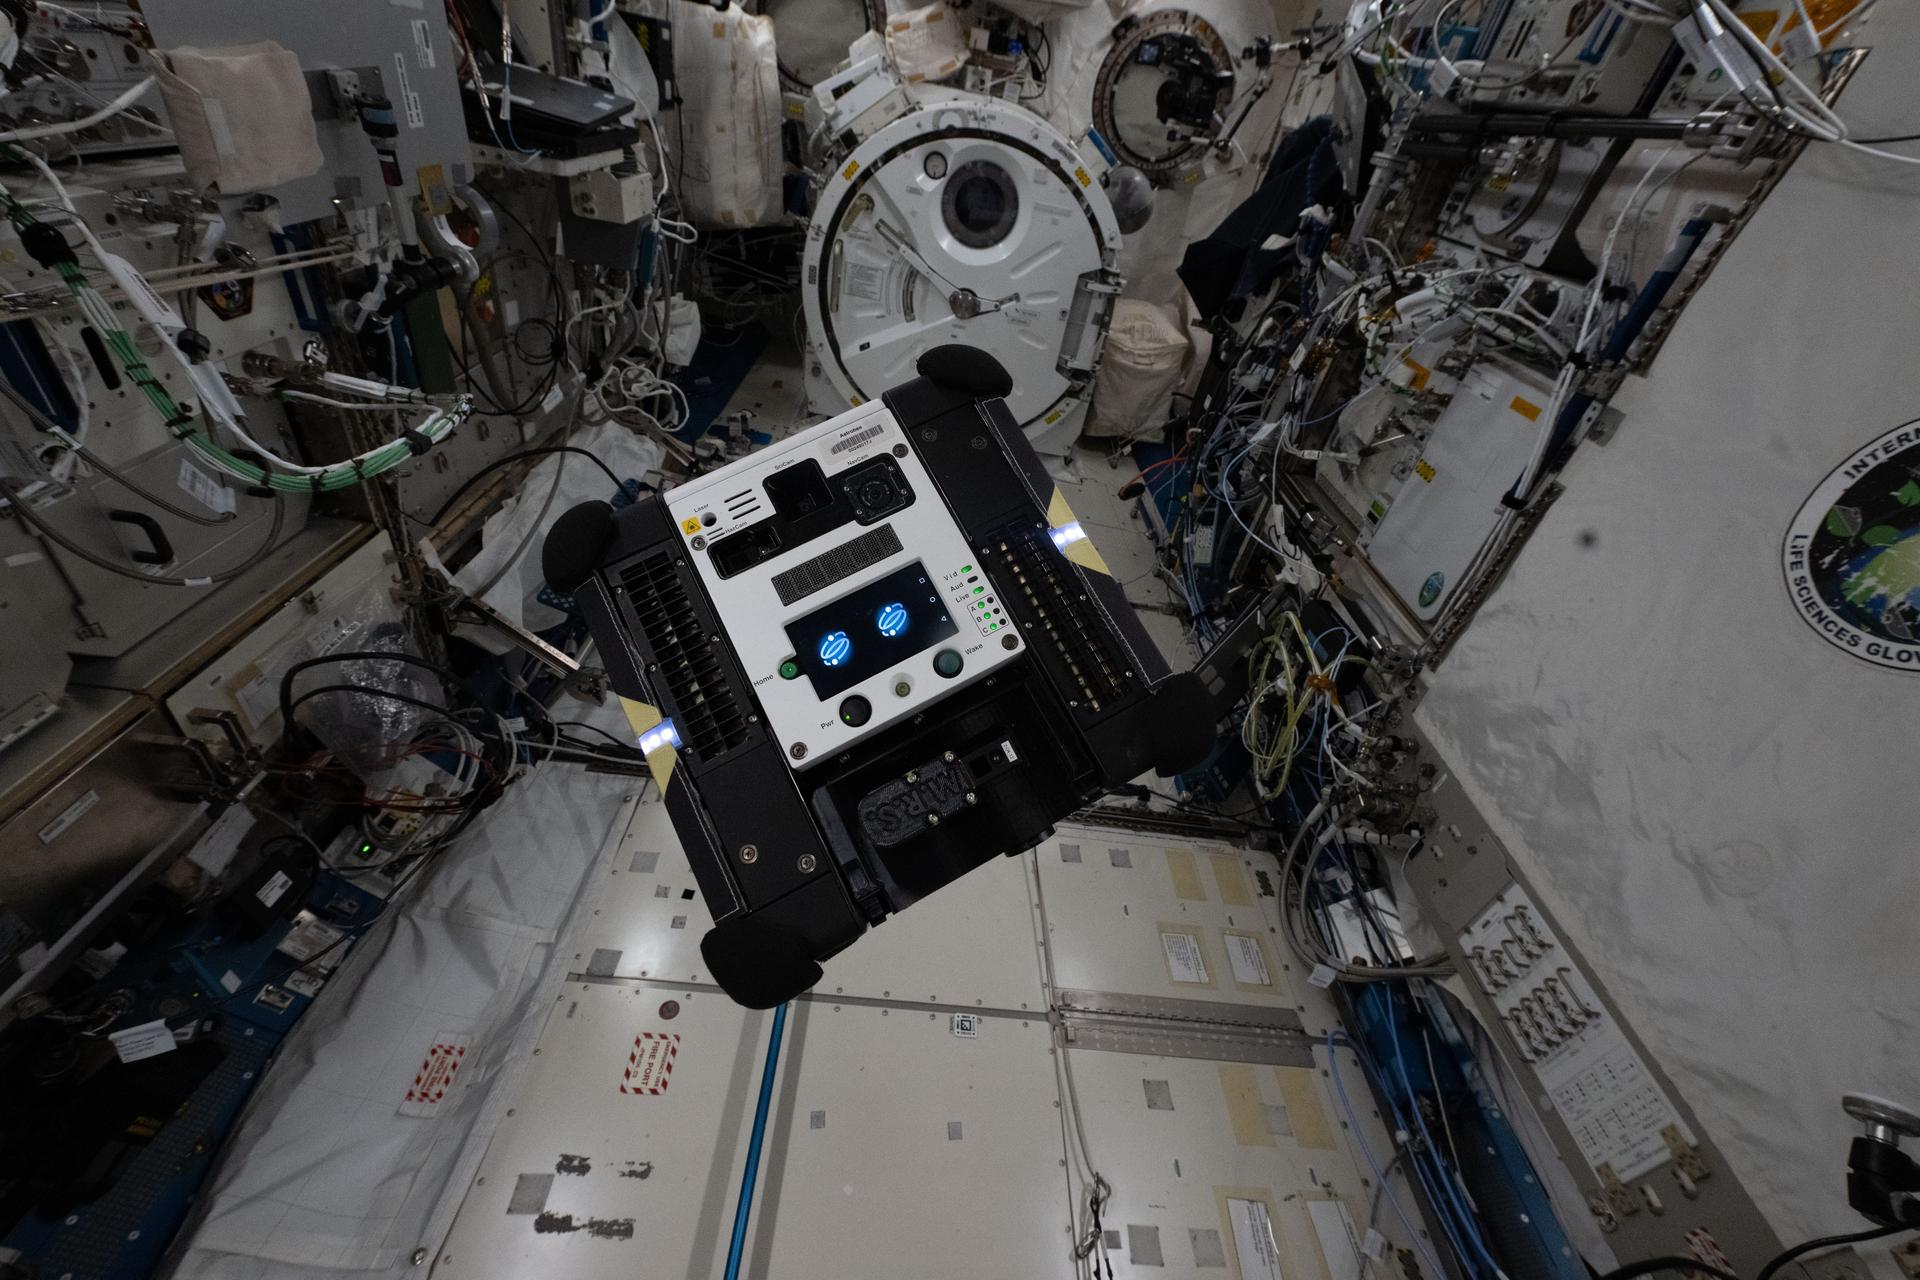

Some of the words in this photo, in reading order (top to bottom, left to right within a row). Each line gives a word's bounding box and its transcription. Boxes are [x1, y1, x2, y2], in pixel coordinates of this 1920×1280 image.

[840, 426, 862, 438] Astrobee
[774, 459, 795, 471] SciCam
[847, 454, 869, 466] NavCam
[693, 503, 709, 513] Laser
[725, 520, 749, 534] HazCam
[1790, 533, 1809, 571] LIFE
[944, 571, 958, 581] Vid
[950, 581, 964, 592] Aud
[955, 593, 970, 603] Live
[1794, 575, 1862, 647] SCIENCES
[964, 643, 984, 655] Wake
[752, 674, 774, 687] Home
[821, 719, 834, 730] Pwr
[649, 1041, 660, 1060] FIRE
[659, 1041, 671, 1074] EMERGENCY
[641, 1062, 654, 1087] PORT
